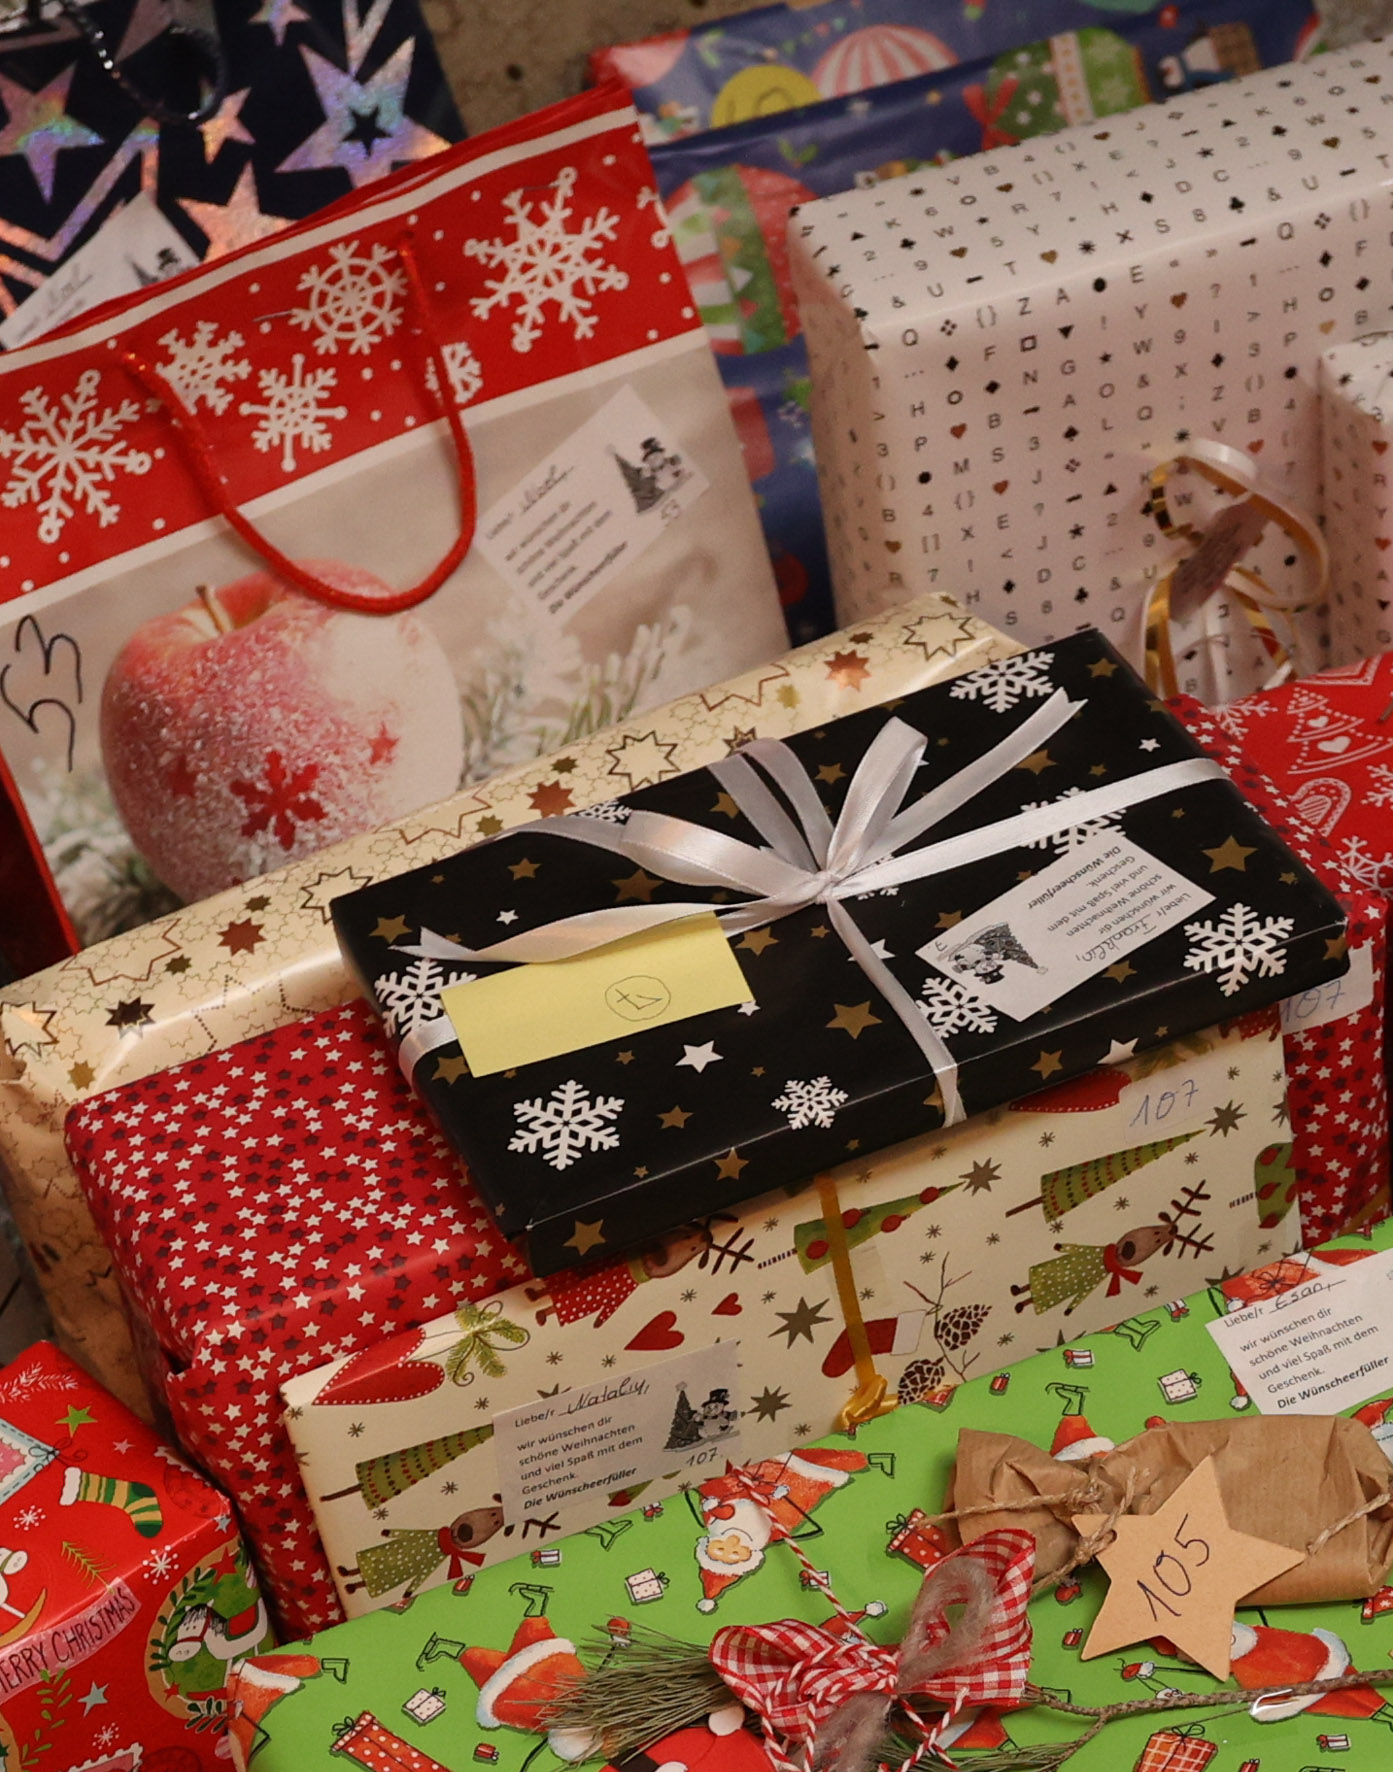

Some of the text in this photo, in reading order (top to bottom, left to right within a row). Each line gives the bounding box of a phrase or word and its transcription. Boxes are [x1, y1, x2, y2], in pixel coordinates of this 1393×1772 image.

[1223, 1306, 1264, 1328] Liebe/r
[1239, 1307, 1332, 1352] wir wünschen dir
[1249, 1315, 1364, 1367] schöne Weihnachten
[1258, 1325, 1379, 1380] und viel Spaß mit dem
[1267, 1367, 1326, 1394] Geschenk.
[1277, 1356, 1389, 1409] Die Wünscheerfüller
[514, 1408, 556, 1428] Liebe/r
[537, 1421, 595, 1445] wünschen
[518, 1424, 636, 1467] schöne Weihnachten
[545, 1467, 637, 1503] Wünscheerfüller
[1135, 1511, 1213, 1624] 105
[50, 1587, 137, 1665] CHRISTMAS
